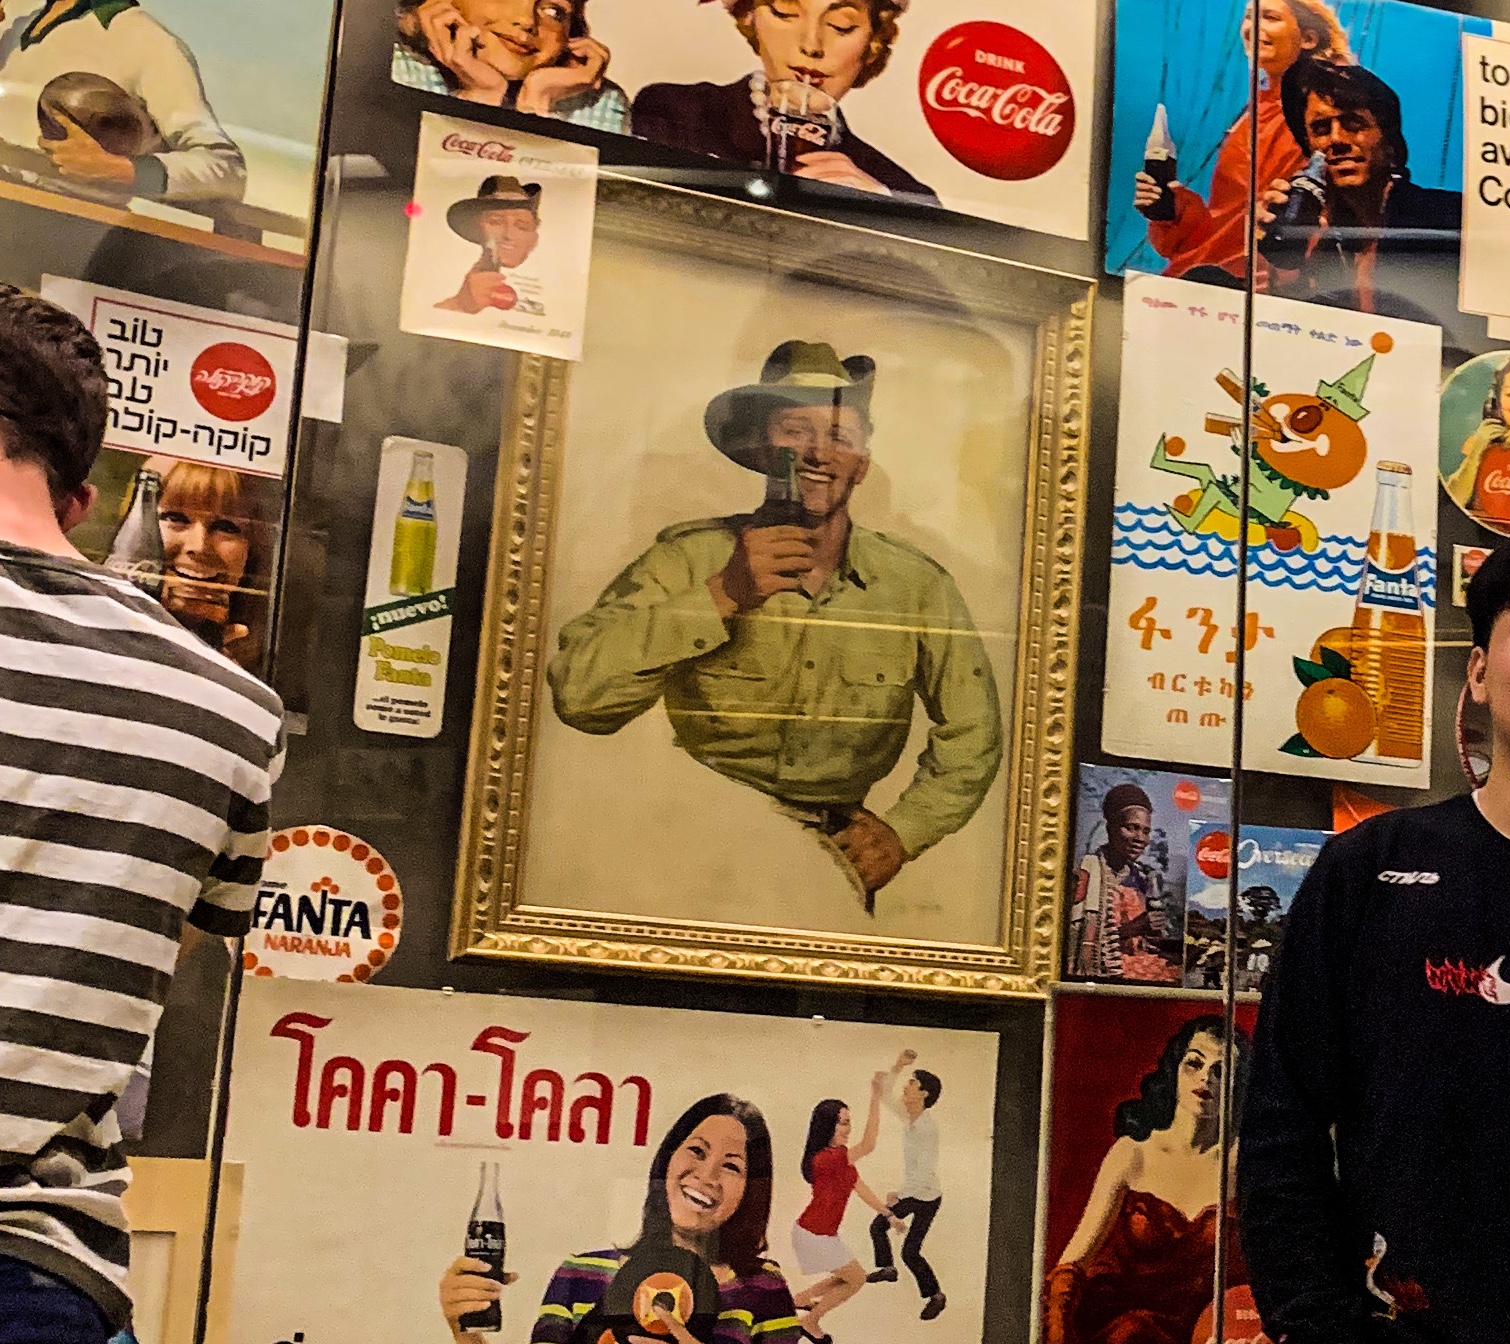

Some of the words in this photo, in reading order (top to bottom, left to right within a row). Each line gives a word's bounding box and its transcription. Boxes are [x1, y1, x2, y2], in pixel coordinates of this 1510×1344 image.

[974, 49, 1026, 75] DRINK
[926, 66, 1070, 137] Coca-Cola
[252, 888, 372, 940] FANTA
[263, 932, 351, 958] NARANJA
